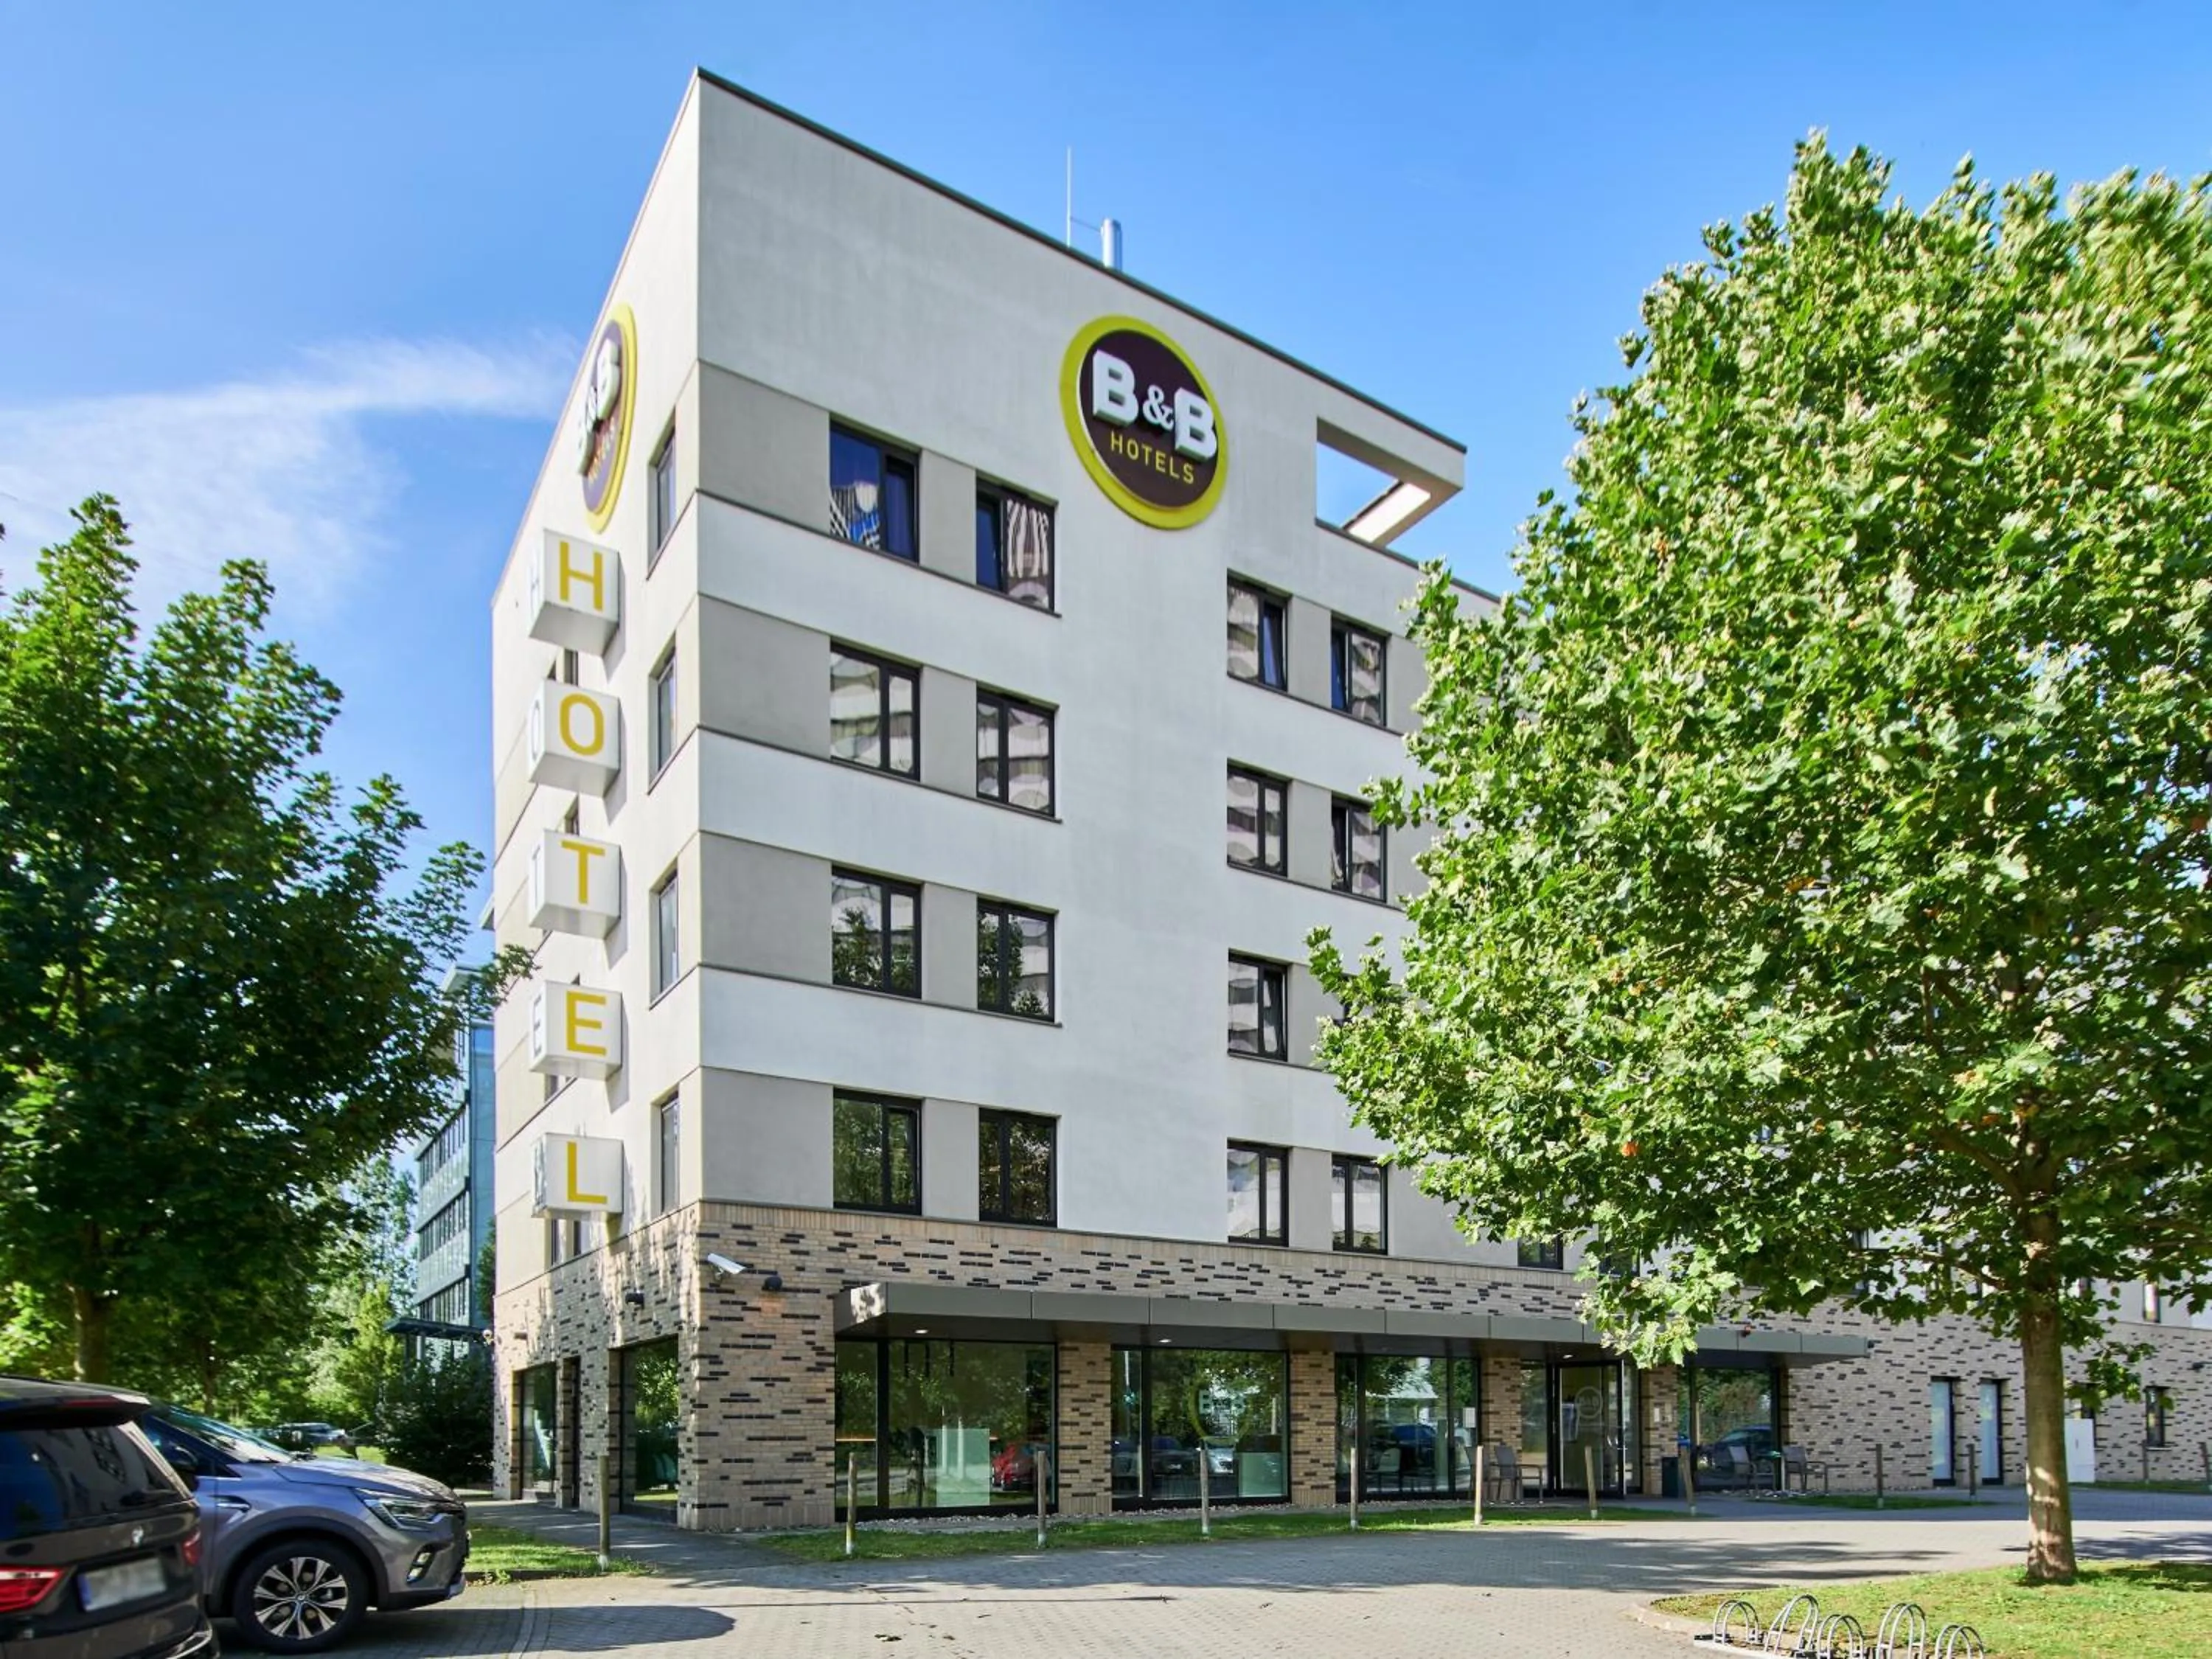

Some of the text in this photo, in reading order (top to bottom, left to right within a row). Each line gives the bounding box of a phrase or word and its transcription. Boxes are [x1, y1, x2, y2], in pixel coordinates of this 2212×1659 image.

[1093, 349, 1217, 462] B&B
[1110, 431, 1195, 484] HOTELS
[559, 540, 608, 1205] HOTEL
